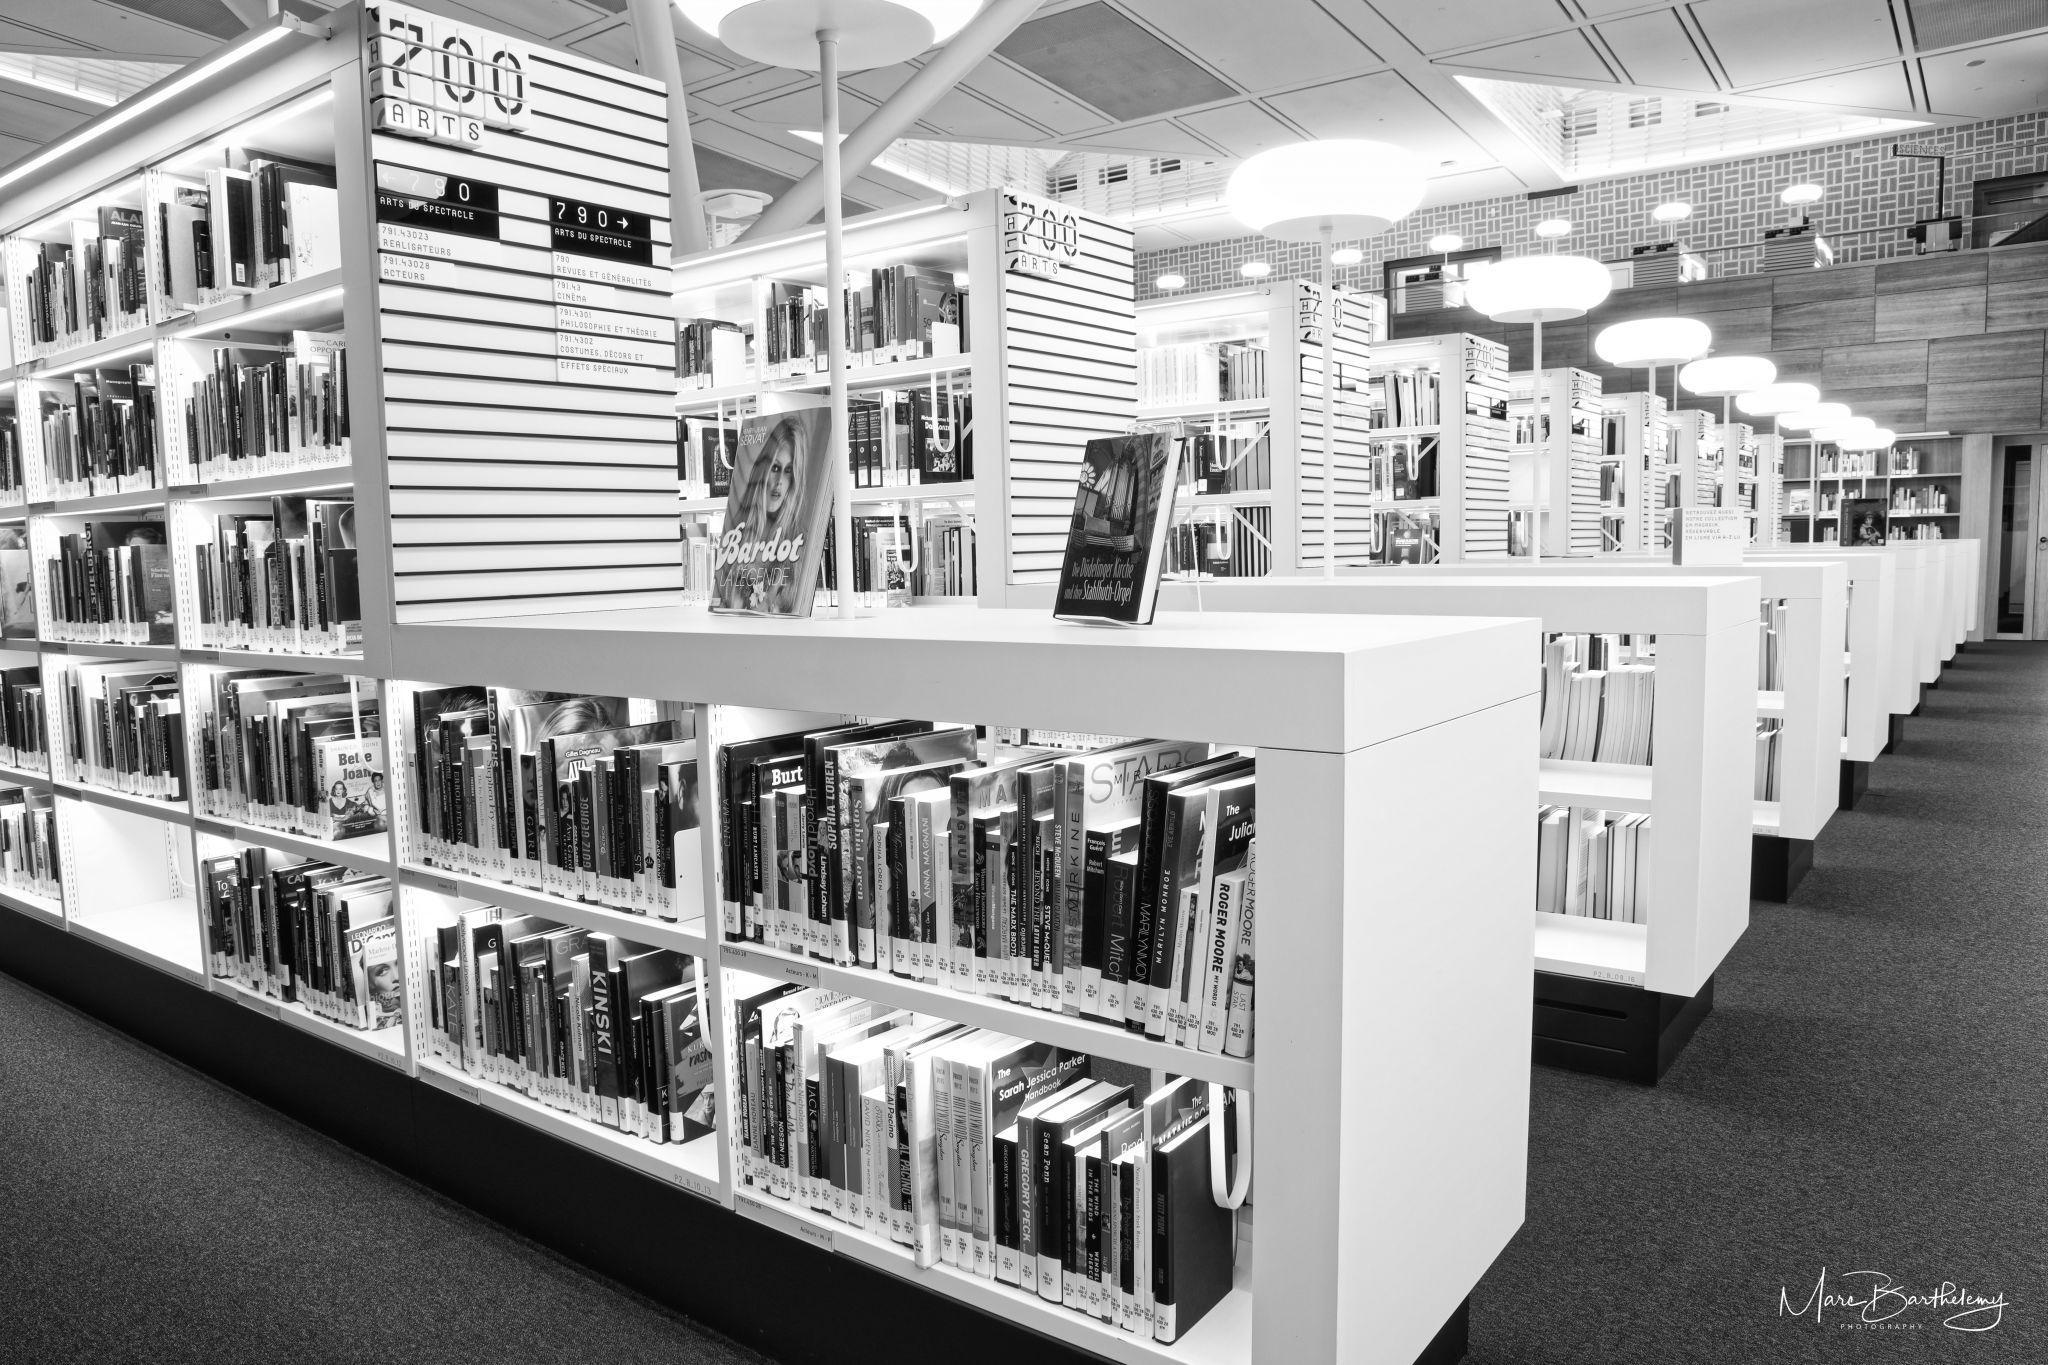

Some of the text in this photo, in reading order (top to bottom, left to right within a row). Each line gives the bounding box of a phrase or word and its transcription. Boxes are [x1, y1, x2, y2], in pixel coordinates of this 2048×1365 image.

[389, 17, 524, 116] 700
[392, 103, 481, 141] ARTS
[1899, 144, 1946, 155] SCIENCES
[380, 196, 474, 221] ARTS DU SPECTACLE
[556, 202, 607, 228] 790
[382, 225, 430, 241] 791.43023
[555, 227, 632, 249] ARTS DU SPECTACLE
[1021, 202, 1077, 257] 700
[383, 255, 431, 270] 791.43028
[556, 254, 571, 264] 790
[1021, 254, 1058, 275] ARTS
[383, 268, 425, 281] ACTEURS
[556, 265, 587, 279] REVUES
[589, 270, 599, 279] ET
[556, 281, 582, 292] 791.43
[556, 291, 588, 303] CINÉMA
[559, 307, 592, 319] 791.4301
[1312, 290, 1342, 328] 70
[560, 318, 612, 332] PHILOSOPHIE
[614, 323, 624, 334] ET
[559, 334, 594, 345] 791.4302
[560, 361, 590, 372] EFFETS
[634, 353, 645, 361] ET
[715, 522, 804, 571] Bardot
[719, 562, 790, 587] LA LÉGENDE
[1113, 558, 1134, 579] Kirche
[488, 695, 499, 768] LEO FUCHS
[565, 750, 579, 758] Gilles
[771, 765, 804, 786] Burt
[806, 788, 818, 833] Harold
[824, 760, 838, 850] SOPHIA LOREN
[1226, 804, 1240, 817] The
[722, 798, 731, 847] CINEMA
[526, 815, 536, 860] GARB
[853, 799, 865, 900] Sophia Loren
[1054, 824, 1062, 878] STEVE McQUEEN
[820, 855, 828, 890] Lindsay
[923, 868, 931, 899] ANNA
[1155, 869, 1171, 964] MARILYN MONROE
[1212, 882, 1230, 974] ROGER MOORE
[1241, 898, 1253, 946] MOORE
[351, 925, 386, 940] LEONARDO
[592, 970, 612, 1055] KINSKI
[1239, 993, 1247, 1011] LAST
[997, 1067, 1011, 1079] The
[999, 1054, 1086, 1101] Sarah Jessica Parker
[807, 1084, 817, 1119] JACK
[1024, 1078, 1061, 1101] Handbook
[1191, 1095, 1202, 1109] The
[863, 1099, 871, 1126] DAVID
[1043, 1131, 1051, 1183] Sean Penn
[900, 1144, 912, 1196] AL PACINO
[1088, 1168, 1094, 1178] IN
[1020, 1150, 1031, 1242] GREGORY PECK
